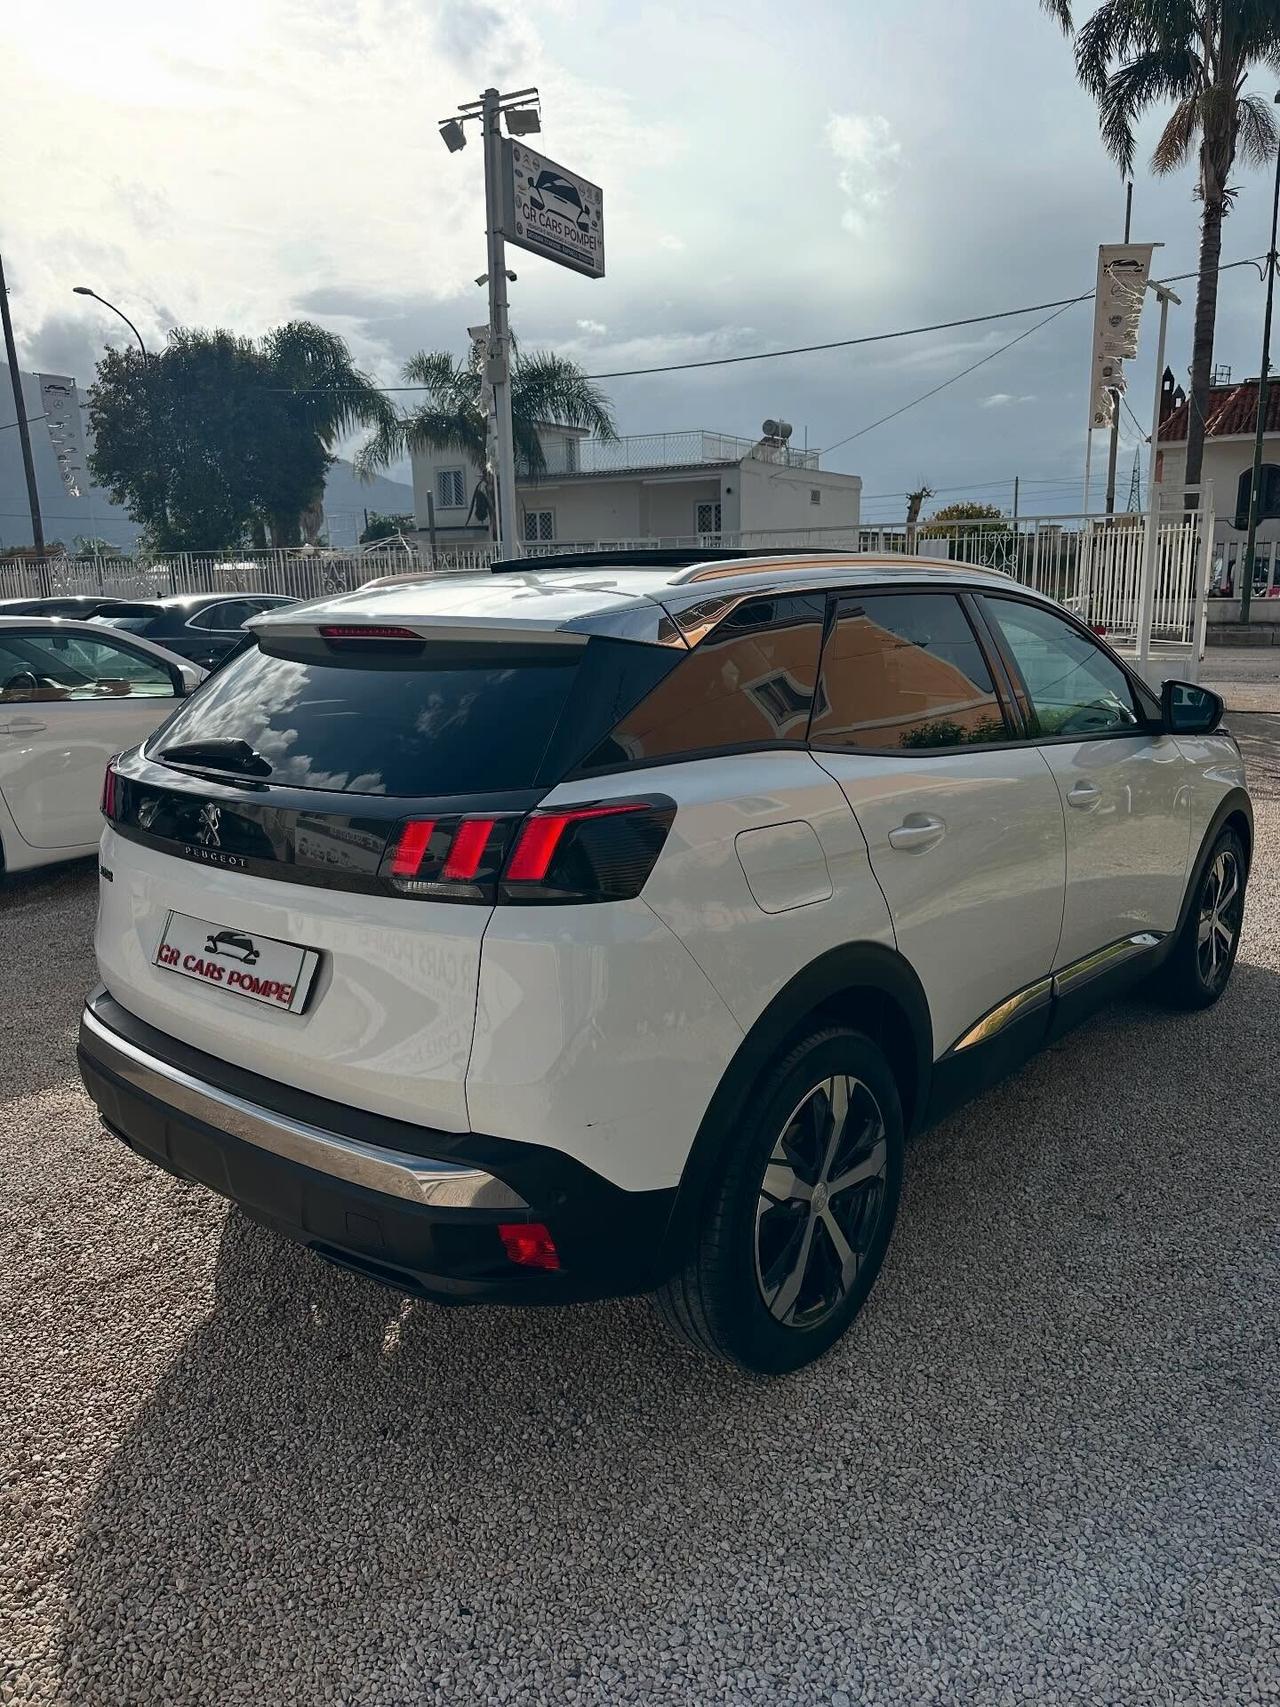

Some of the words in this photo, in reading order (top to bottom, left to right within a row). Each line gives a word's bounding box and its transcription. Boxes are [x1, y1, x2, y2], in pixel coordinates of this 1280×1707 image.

[522, 203, 537, 223] GR
[538, 213, 562, 235] CARS
[564, 225, 597, 251] POMPEI
[184, 846, 247, 867] PEUGEOT
[158, 943, 181, 967] GR
[182, 954, 226, 981] CARS
